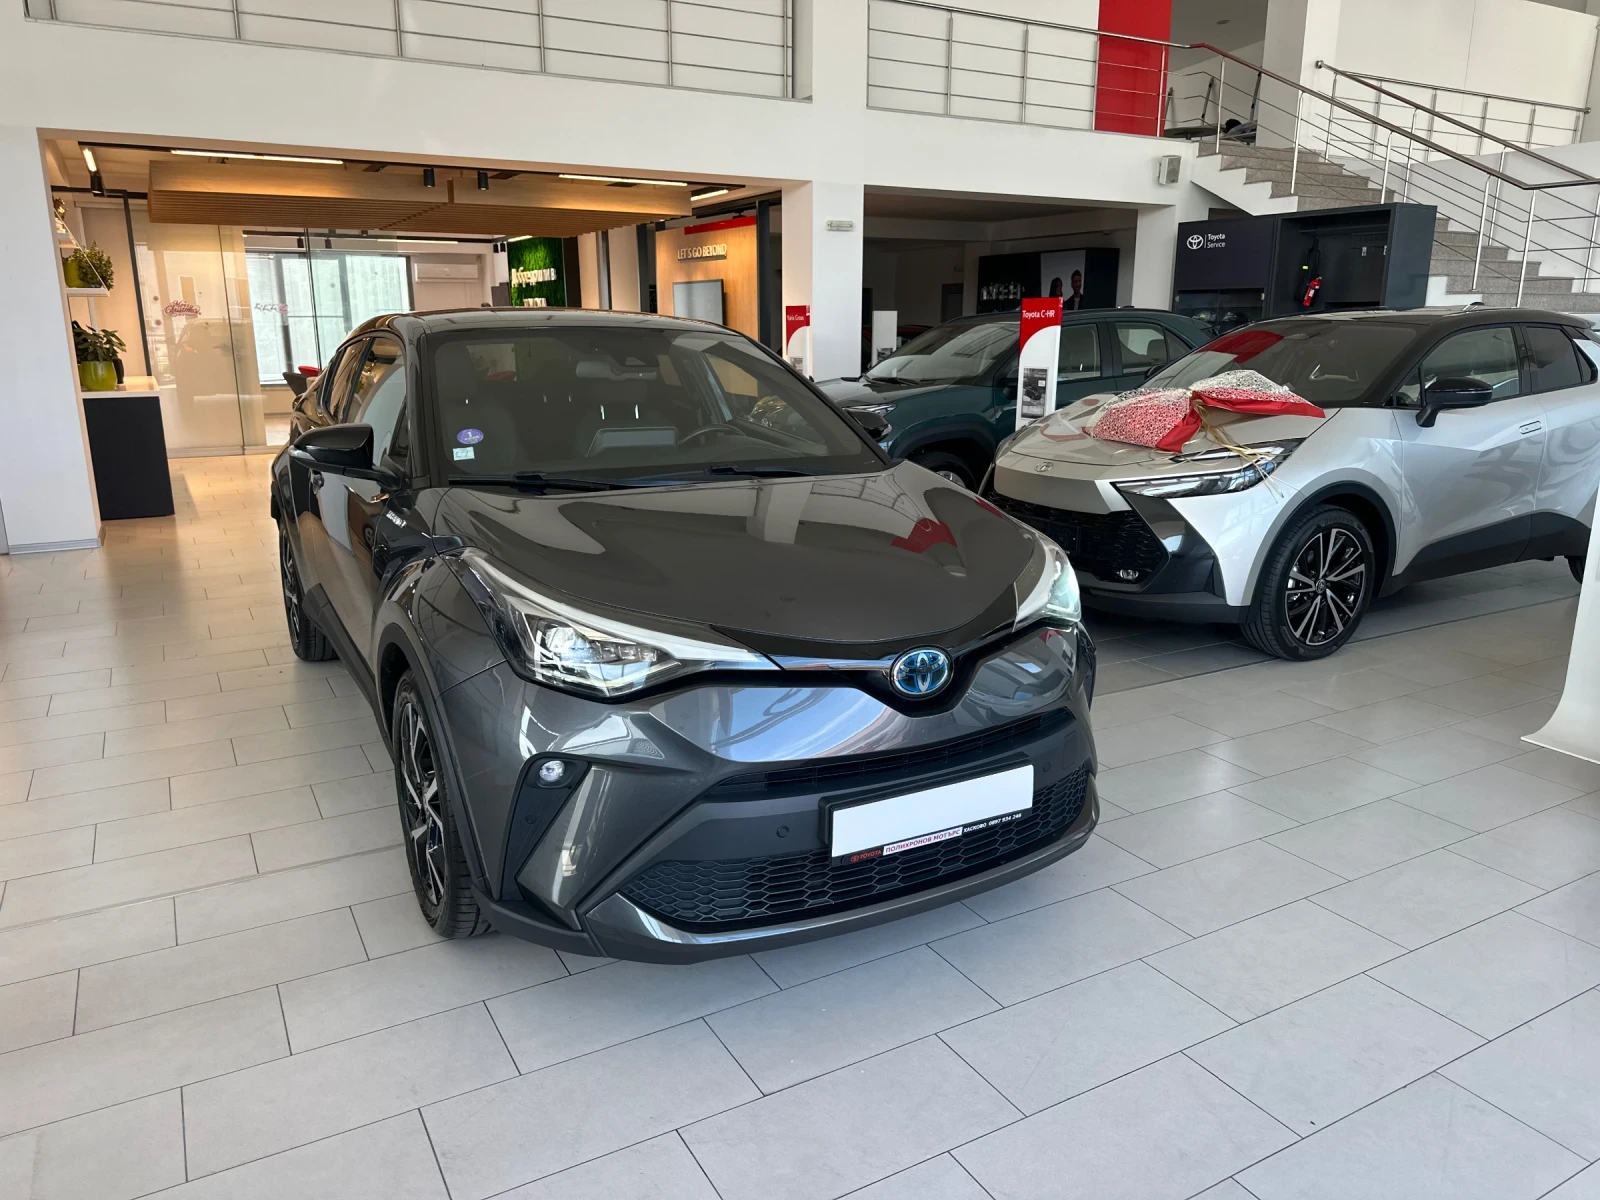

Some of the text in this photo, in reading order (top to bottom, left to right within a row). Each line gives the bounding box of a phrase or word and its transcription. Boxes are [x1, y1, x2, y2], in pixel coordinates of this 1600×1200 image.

[1207, 233, 1226, 241] Toyota
[1207, 241, 1226, 249] Service
[677, 243, 727, 260] LET'S GO BEYOND
[1022, 309, 1056, 320] Toyota C-HR
[963, 823, 987, 833] ХАСКОВО
[885, 829, 961, 854] ПОЛИХРОНОВ МОТЪРС
[860, 850, 882, 860] TOYOTA
